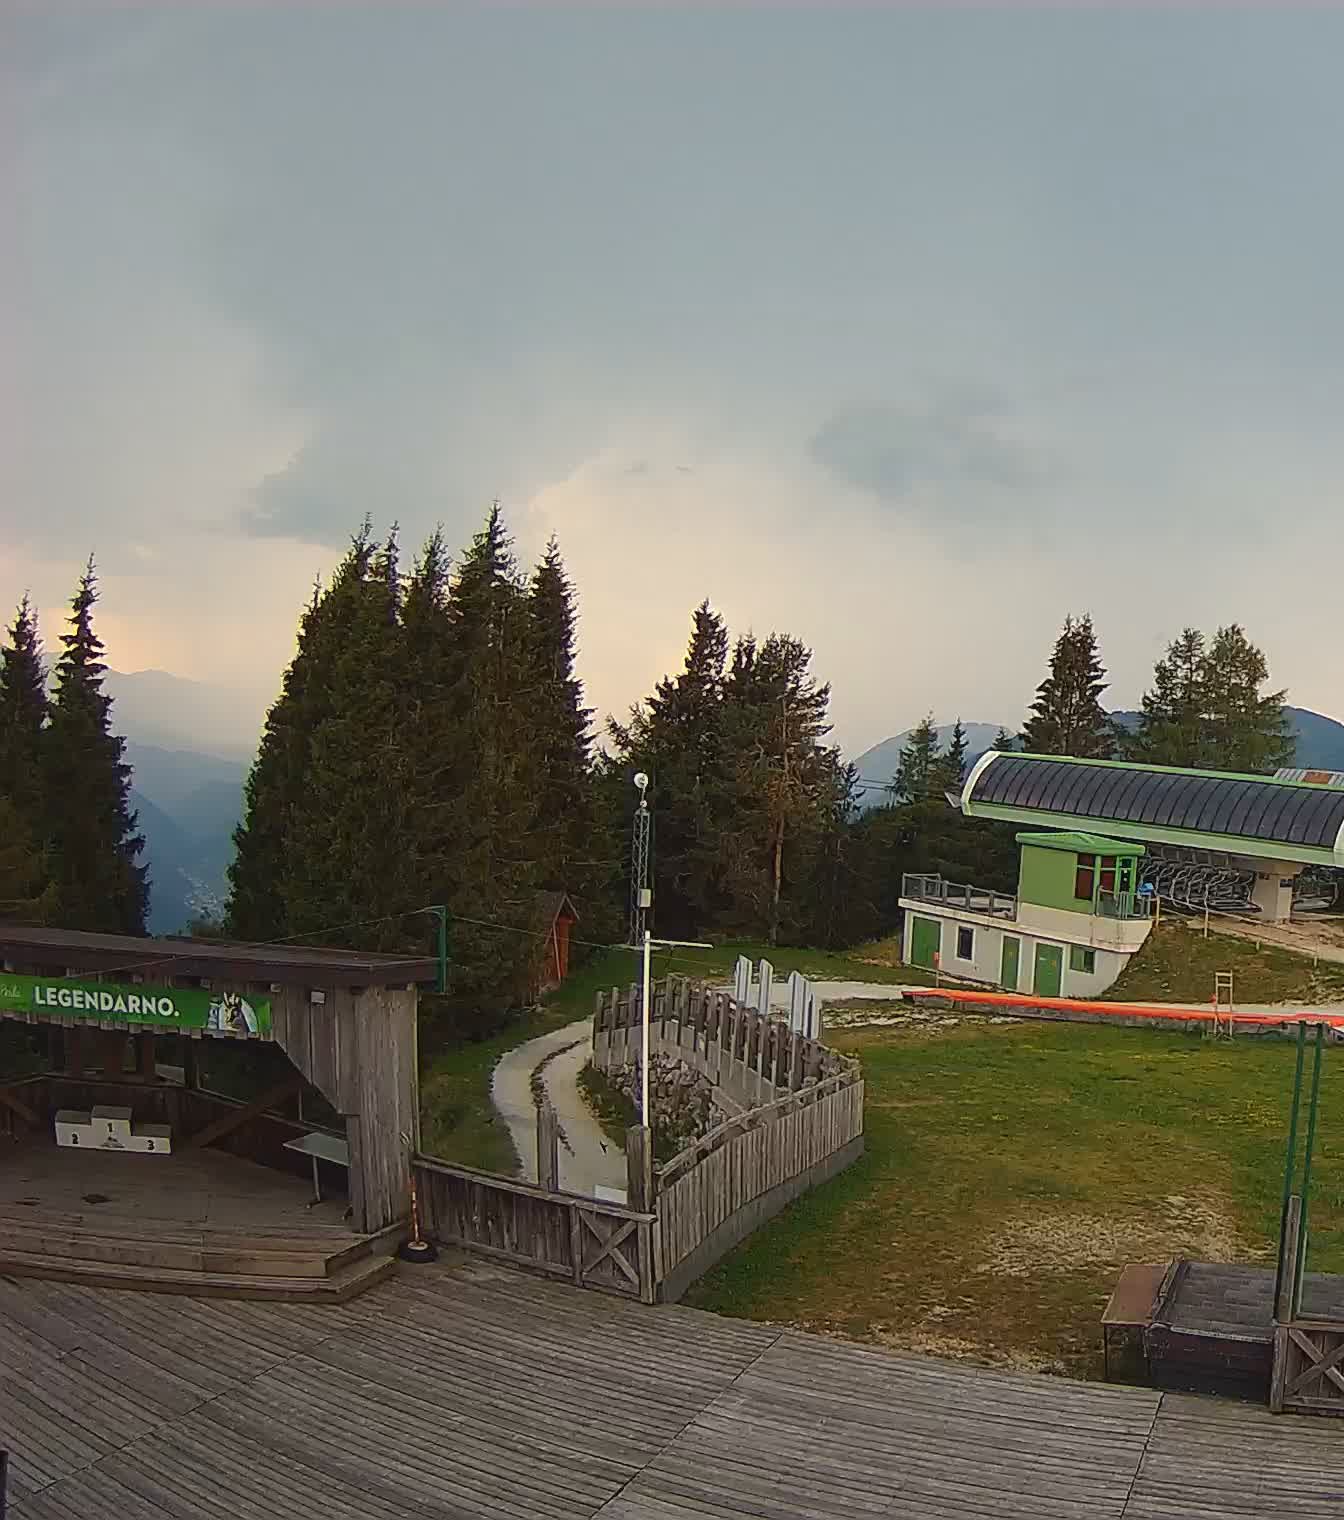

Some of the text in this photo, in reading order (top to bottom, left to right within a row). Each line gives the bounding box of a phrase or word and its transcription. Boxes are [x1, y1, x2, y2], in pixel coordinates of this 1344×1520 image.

[35, 985, 181, 1018] LEGENDARNO.
[71, 1133, 79, 1145] 2
[147, 1139, 155, 1151] 3
